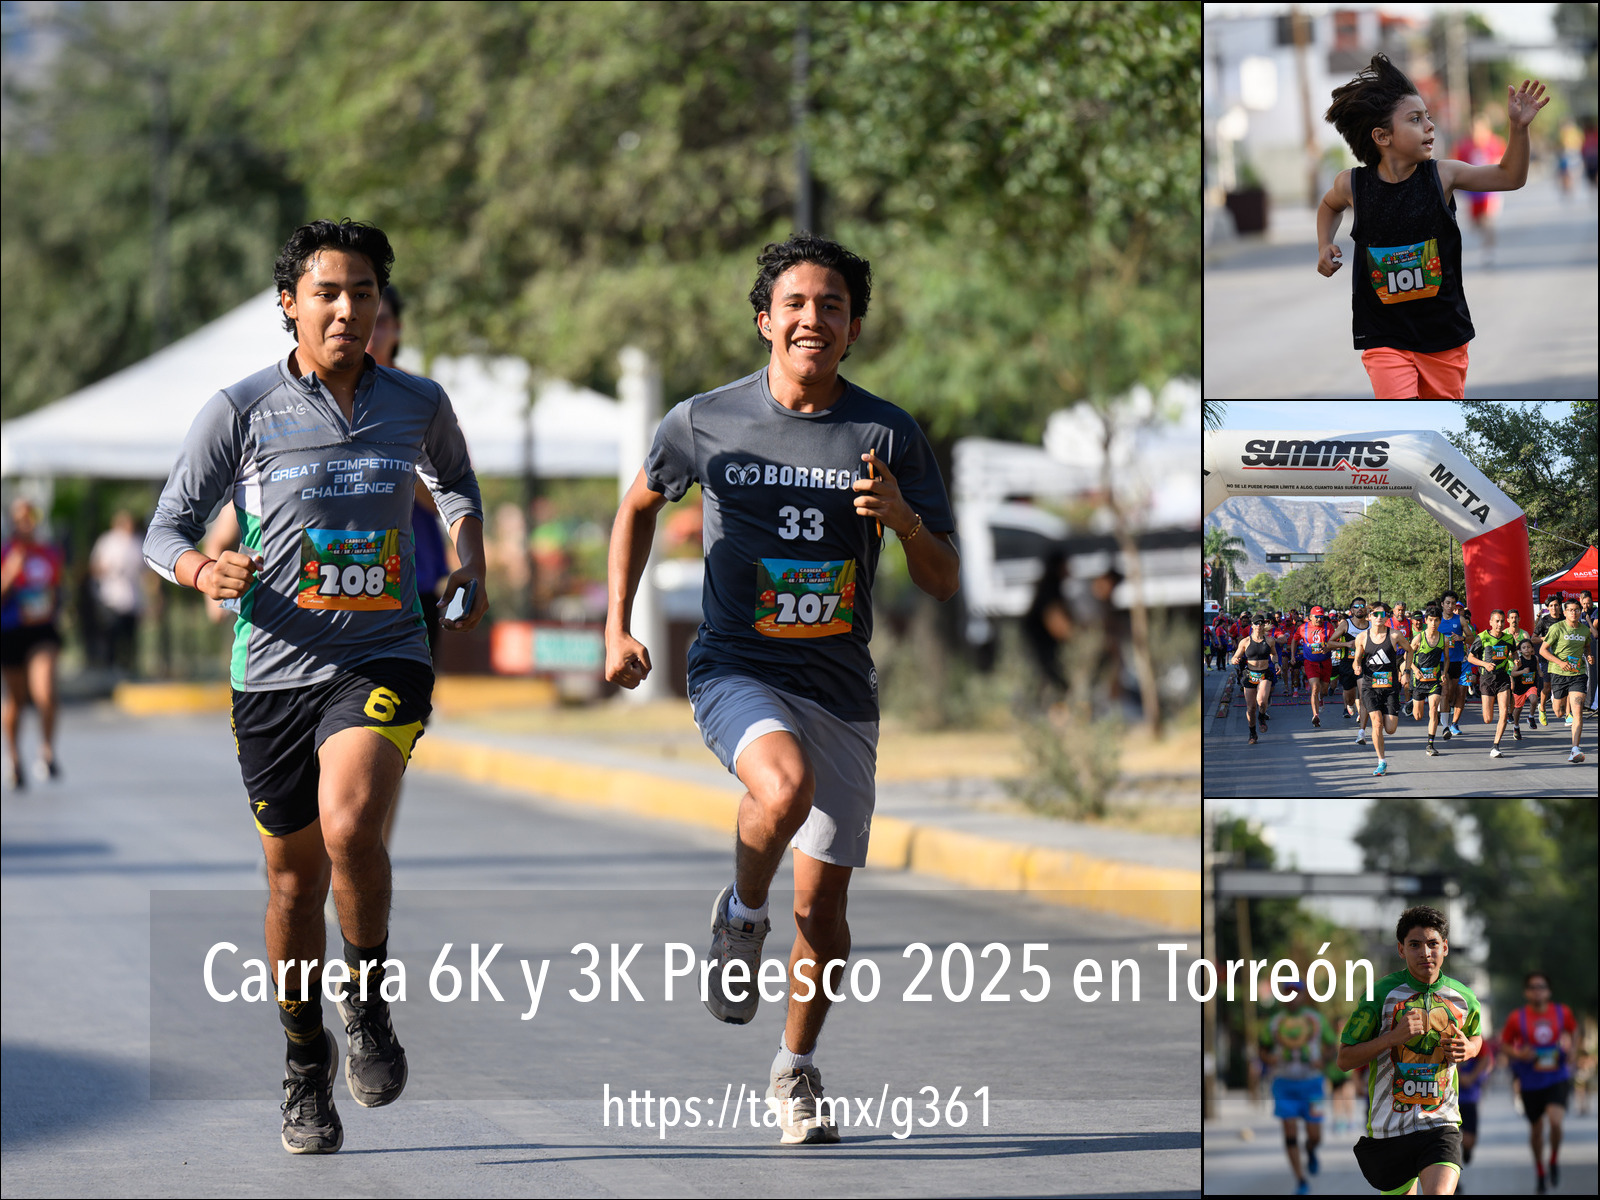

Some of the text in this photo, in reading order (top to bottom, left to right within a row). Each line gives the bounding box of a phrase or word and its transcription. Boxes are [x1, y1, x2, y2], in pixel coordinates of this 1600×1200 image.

[1387, 267, 1424, 294] 101
[271, 458, 414, 482] GREAT COMPETITIO
[334, 471, 363, 484] and
[1351, 474, 1390, 484] TRAIL
[301, 482, 396, 500] CHALLENGE
[1429, 463, 1491, 525] META
[778, 505, 825, 541] 33
[318, 563, 386, 596] 208
[776, 592, 841, 624] 207
[364, 686, 401, 723] 6
[1403, 1080, 1438, 1098] 044
